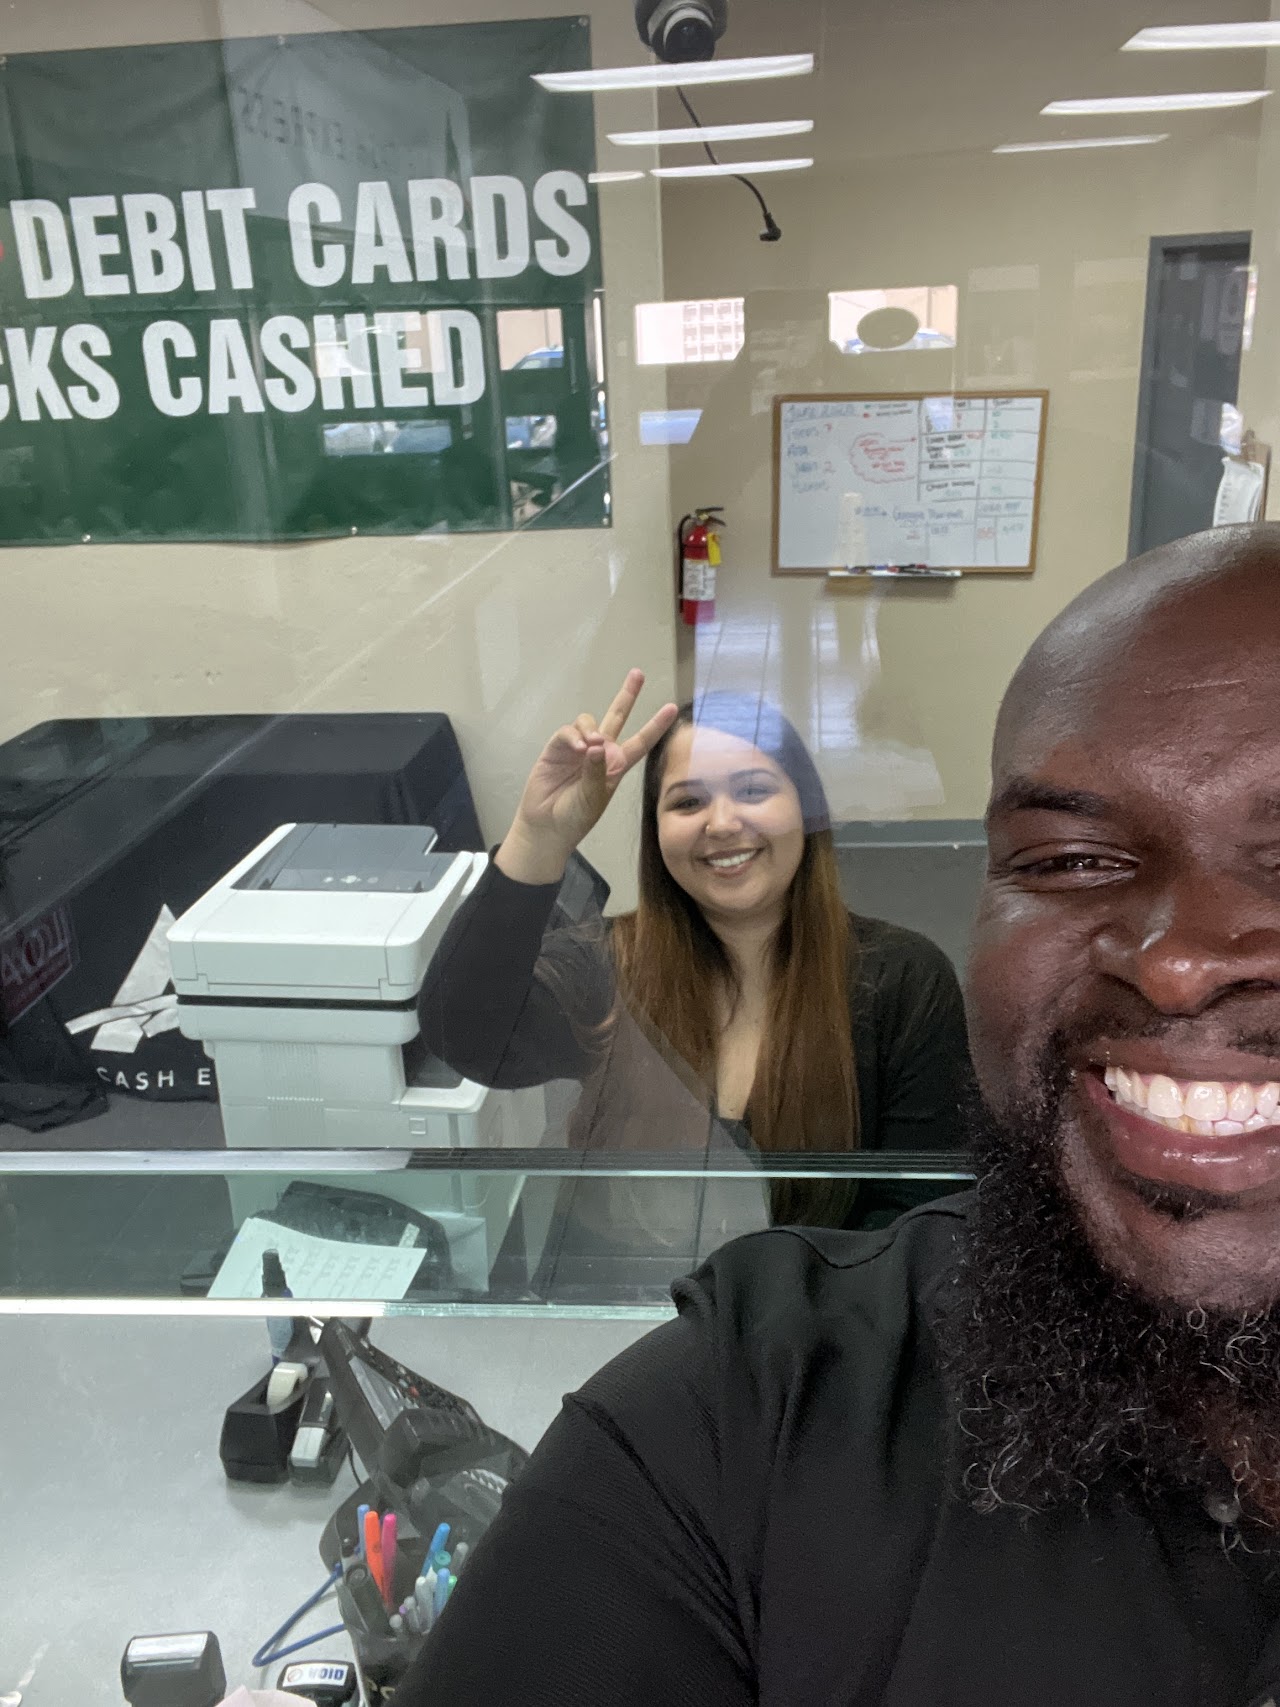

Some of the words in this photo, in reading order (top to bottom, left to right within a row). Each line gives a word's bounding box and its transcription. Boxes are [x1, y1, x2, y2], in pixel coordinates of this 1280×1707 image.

[10, 187, 257, 299] DEBIT
[288, 170, 591, 288] CARDS
[0, 322, 120, 421] KS
[142, 310, 486, 417] CASHED
[96, 1066, 175, 1091] CASH
